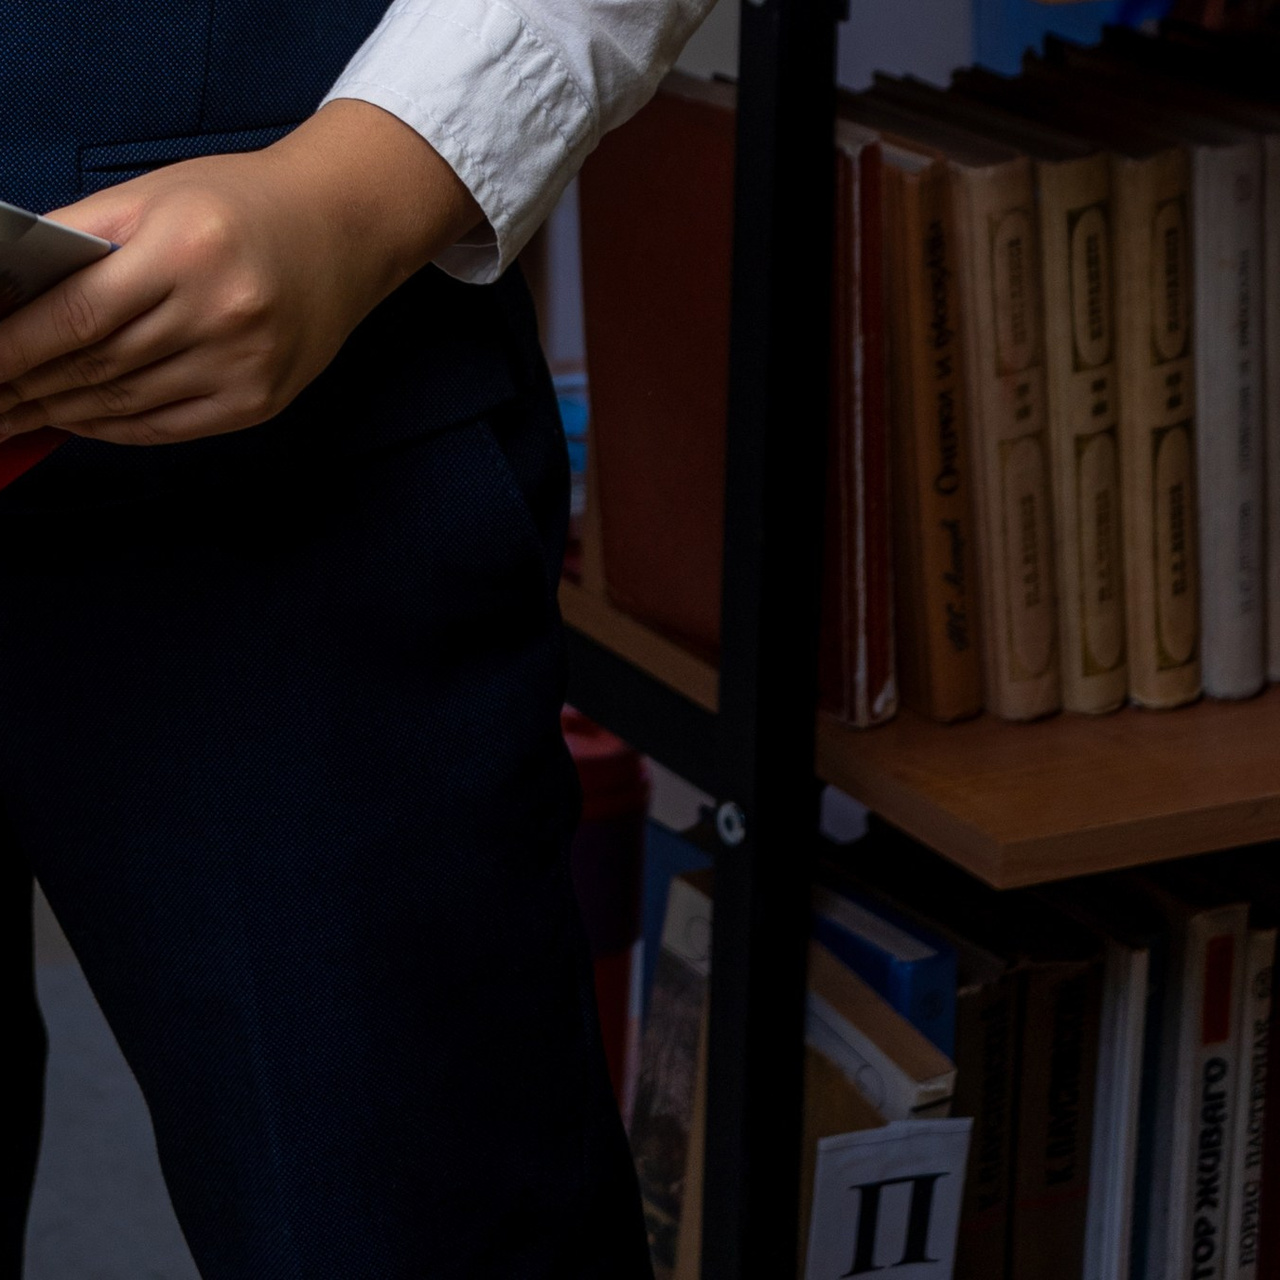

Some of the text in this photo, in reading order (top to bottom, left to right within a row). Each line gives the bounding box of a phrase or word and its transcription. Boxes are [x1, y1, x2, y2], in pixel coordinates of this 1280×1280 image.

[1237, 1018, 1272, 1268] БОРИС ПАСТЕРНАК
[841, 1171, 951, 1278] П
[1191, 1216, 1220, 1280] ТОР
